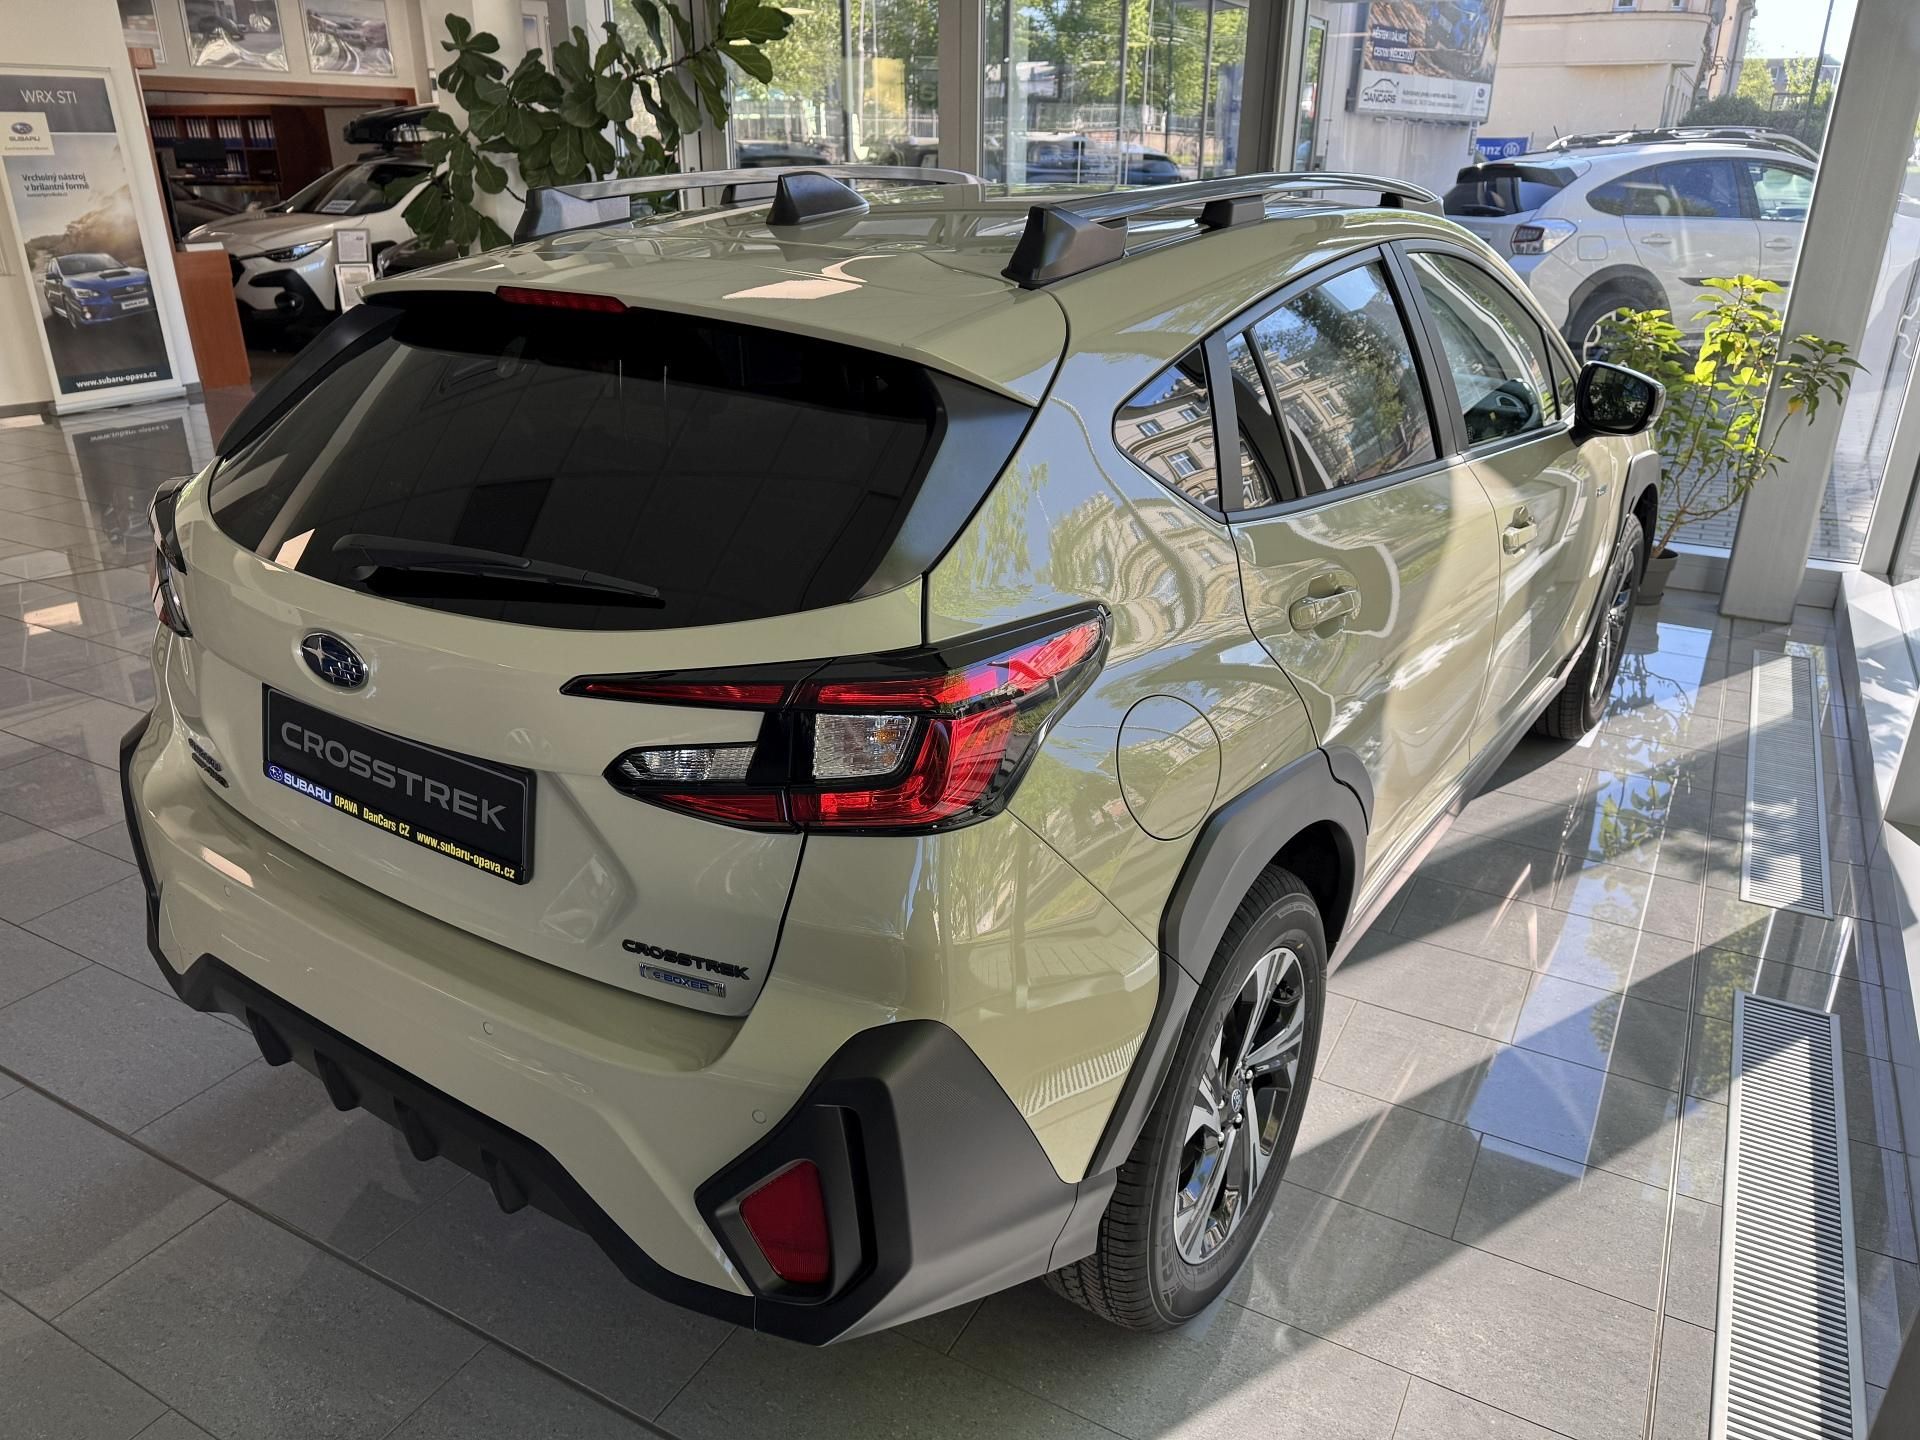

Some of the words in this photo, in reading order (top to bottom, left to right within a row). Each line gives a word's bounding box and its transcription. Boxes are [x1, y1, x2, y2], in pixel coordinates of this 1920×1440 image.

[20, 89, 55, 104] WRX
[57, 90, 78, 104] STI
[22, 172, 57, 183] Vrcholný
[58, 172, 87, 183] nástroj
[31, 182, 65, 192] brilantní
[65, 181, 91, 191] formě
[76, 370, 157, 389] www.subaru-opava.cz
[281, 721, 507, 832] CROSSTREK
[283, 772, 332, 804] SUBARU
[334, 794, 359, 816] OPAVA
[363, 807, 397, 832] DanCars
[398, 823, 411, 838] CZ
[416, 831, 516, 880] www.subaru-opava.cz
[622, 938, 750, 981] CROSSTREK
[652, 970, 710, 992] e-BOXER
